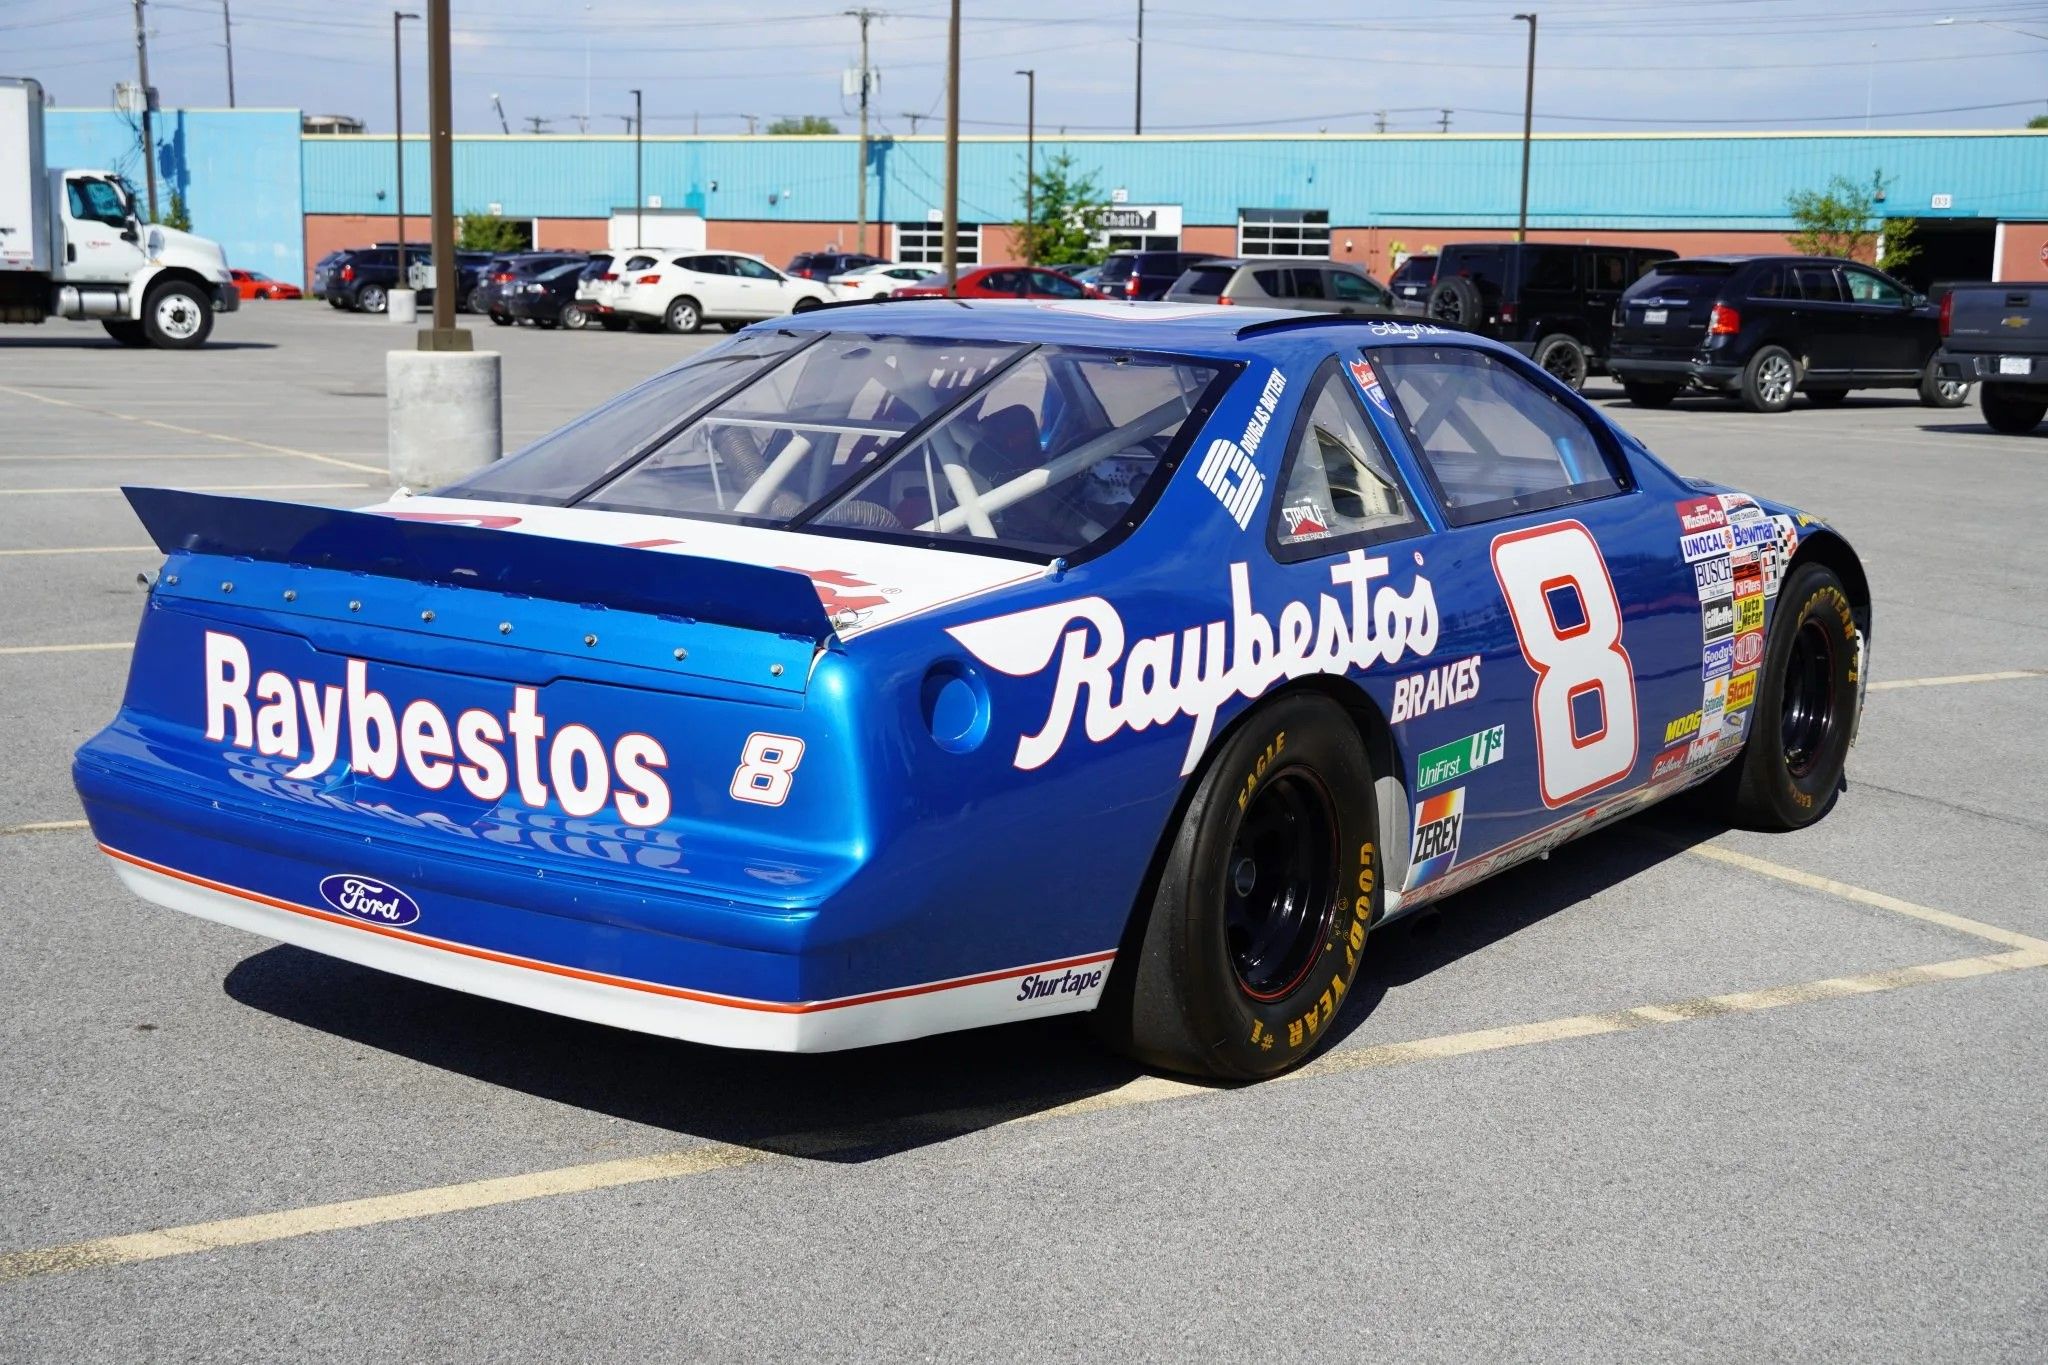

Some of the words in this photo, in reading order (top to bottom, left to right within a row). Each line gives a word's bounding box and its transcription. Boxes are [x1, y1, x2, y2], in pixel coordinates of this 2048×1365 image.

[1239, 407, 1271, 457] DOUGLAS
[1260, 367, 1287, 414] BATTERY
[1282, 504, 1328, 534] STAVOLA
[1732, 522, 1776, 546] Bowman
[1684, 532, 1726, 557] UNOCAL
[1696, 557, 1732, 587] BUSCH
[1705, 605, 1733, 630] Gillette
[1742, 610, 1763, 627] Meter
[1744, 598, 1760, 612] Auto
[945, 549, 1439, 777] Raybestos
[1490, 519, 1640, 810] 8
[1704, 643, 1734, 664] Goody's
[1390, 655, 1481, 724] BRAKES
[204, 629, 672, 827] Raybestos
[729, 731, 806, 807] 8
[1238, 731, 1288, 812] EAGLE
[1419, 755, 1462, 788] UniFirst
[1412, 812, 1462, 865] ZEREX
[339, 878, 400, 921] Ford
[1016, 969, 1102, 1002] Shurtape
